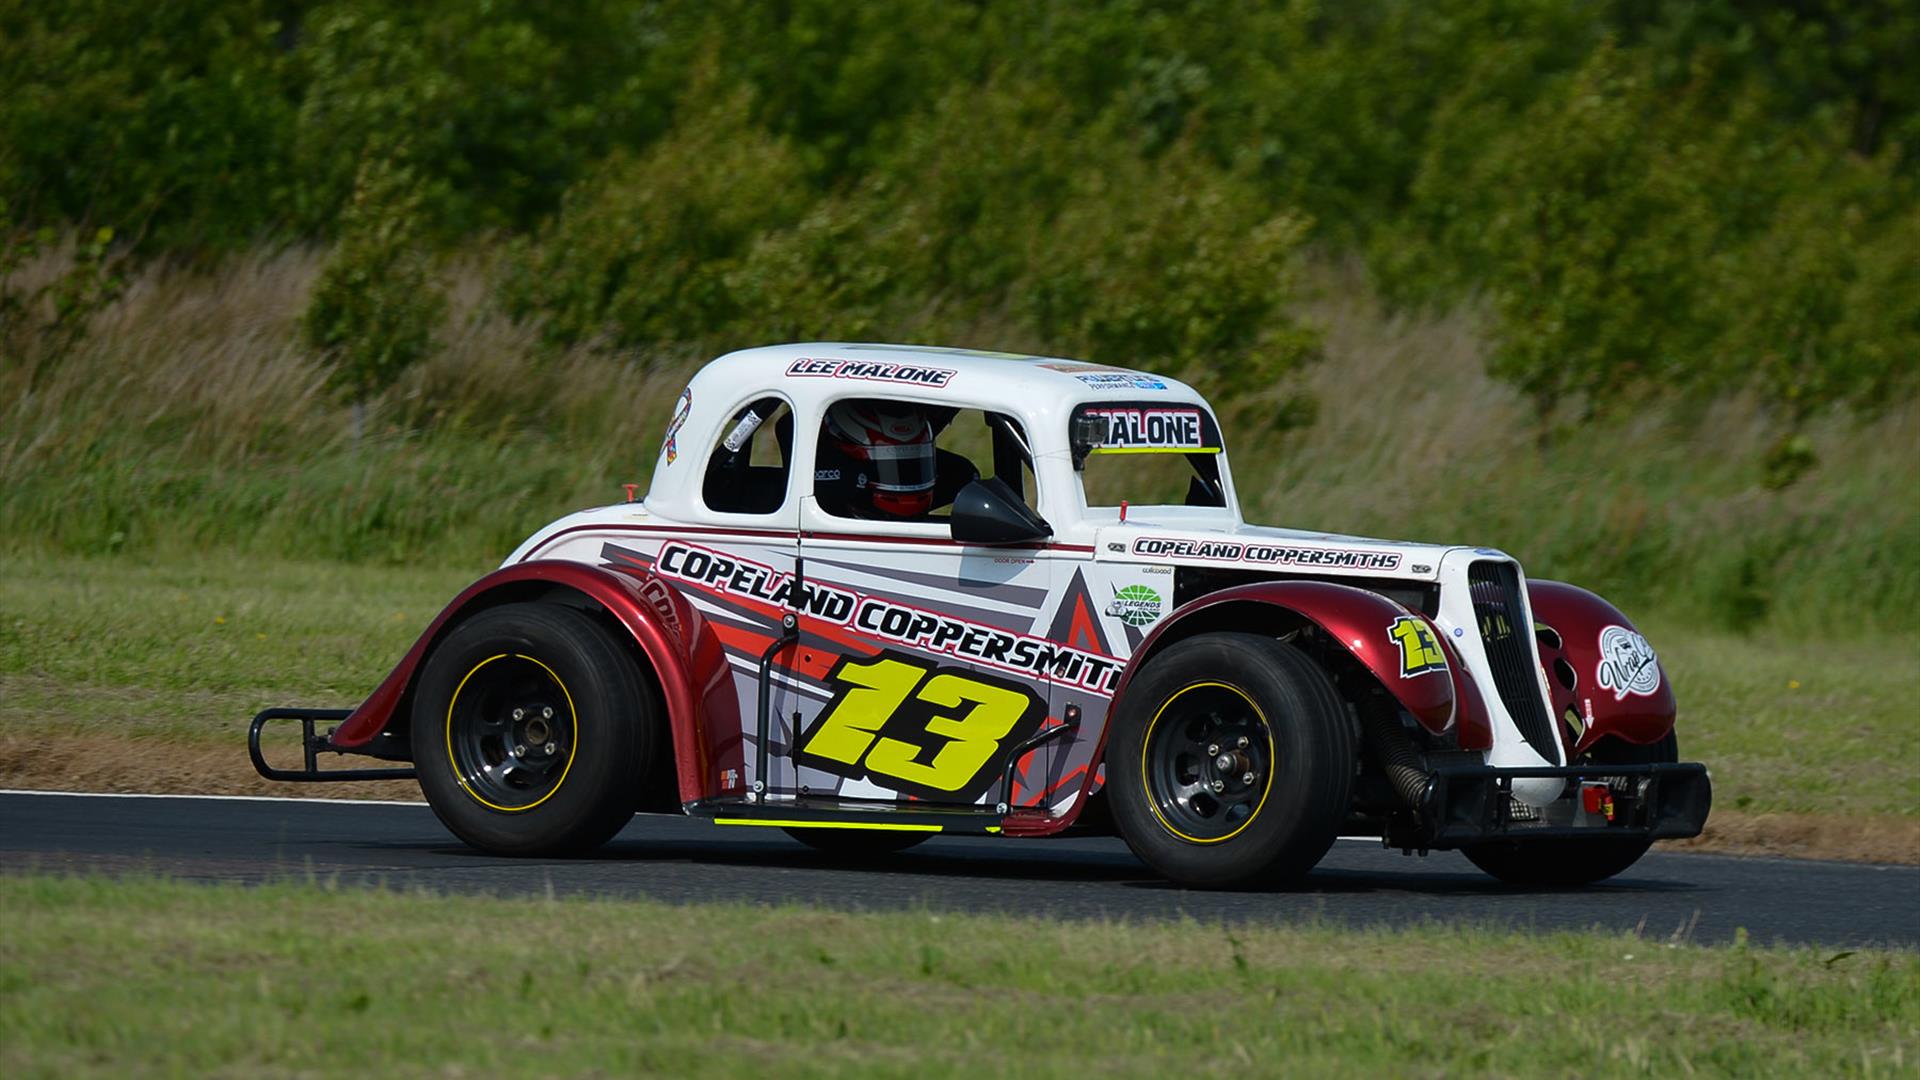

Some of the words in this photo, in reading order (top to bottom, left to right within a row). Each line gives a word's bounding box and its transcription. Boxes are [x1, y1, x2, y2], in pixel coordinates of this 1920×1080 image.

[790, 361, 841, 373] LEE
[840, 362, 952, 384] MALONE
[1135, 539, 1241, 559] COPELAND
[1245, 546, 1399, 568] COPPERSMITHS
[660, 545, 855, 622] COPELAND
[1124, 600, 1161, 609] LEGENDS
[1391, 618, 1447, 671] 13
[1600, 647, 1641, 690] Wrap
[802, 658, 1031, 793] 13
